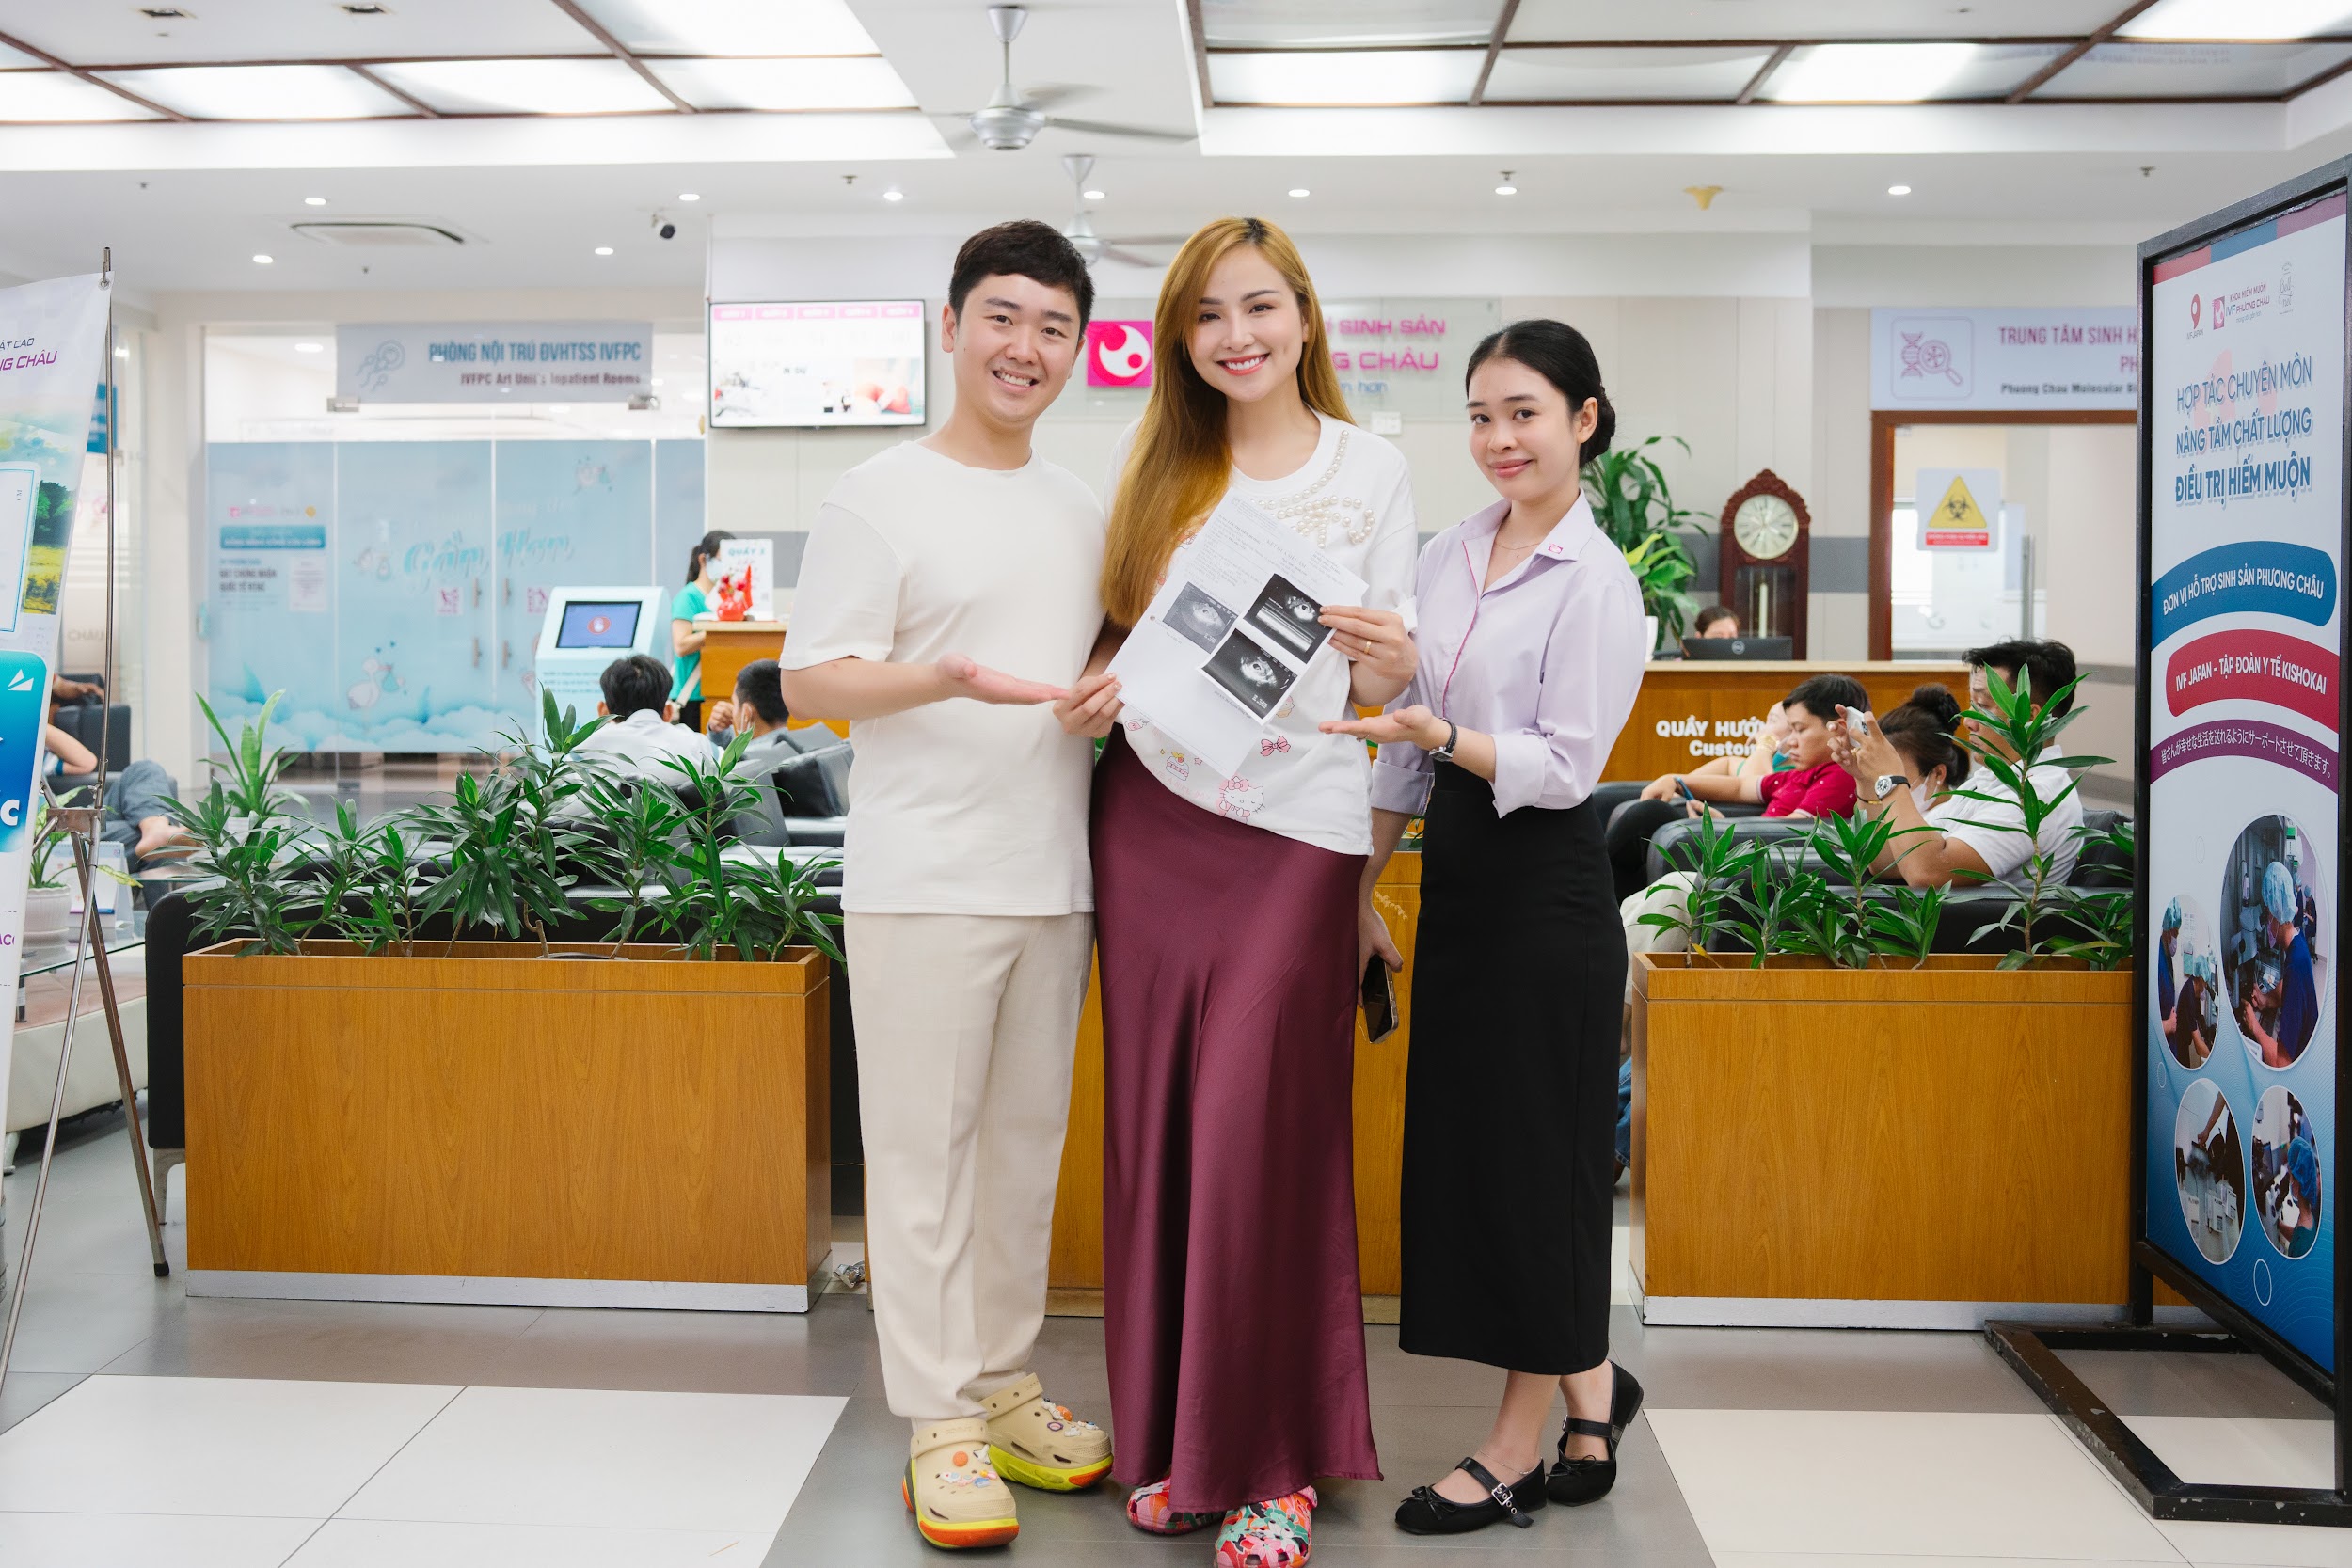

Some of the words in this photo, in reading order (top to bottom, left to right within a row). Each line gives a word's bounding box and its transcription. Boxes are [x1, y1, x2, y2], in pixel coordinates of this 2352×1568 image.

[2226, 304, 2236, 317] IVF
[1338, 319, 1392, 335] SINH
[1400, 313, 1446, 335] SẢN
[1998, 325, 2047, 347] TRUNG
[2052, 323, 2083, 346] TÂM
[2088, 325, 2122, 346] SINH
[13, 337, 35, 349] CAO
[429, 340, 477, 362] PHÒNG
[481, 339, 505, 365] NỘI
[509, 340, 536, 362] TRÚ
[540, 341, 596, 362] ĐVHTSS
[599, 341, 642, 362] IVFPC
[16, 349, 58, 369] CHÂU
[1359, 346, 1439, 370] CHÂU
[460, 373, 492, 385] IVFPC
[2177, 383, 2201, 417] HỢP
[2202, 373, 2225, 405] TÁC
[2227, 359, 2277, 400] CHUYÊN
[2280, 352, 2312, 388] MÔN
[2176, 425, 2206, 455] NÂNG
[2208, 417, 2231, 450] TẦM
[2233, 407, 2265, 445] CHẤT
[2267, 406, 2312, 443] LƯỢNG
[2175, 463, 2202, 502] ĐIỀU
[2205, 468, 2225, 505] TRỊ
[2228, 453, 2261, 496] HIẾM
[2265, 450, 2311, 498] MUỘN
[2163, 592, 2180, 616] ĐƠN
[2179, 586, 2188, 608] VỊ
[2201, 572, 2217, 596] TRỢ
[2218, 569, 2236, 590] SINH
[2238, 562, 2255, 587] SẢN
[2256, 567, 2296, 591] PHƯƠNG
[2296, 573, 2325, 600] CHÂU
[2175, 671, 2187, 692] IVF
[2188, 661, 2213, 686] JAPAN
[2218, 653, 2234, 680] TẬP
[2235, 651, 2261, 674] ĐOÀN
[2262, 657, 2269, 675] Y
[2269, 653, 2282, 678] TẾ
[2281, 660, 2328, 695] KISHOKAI
